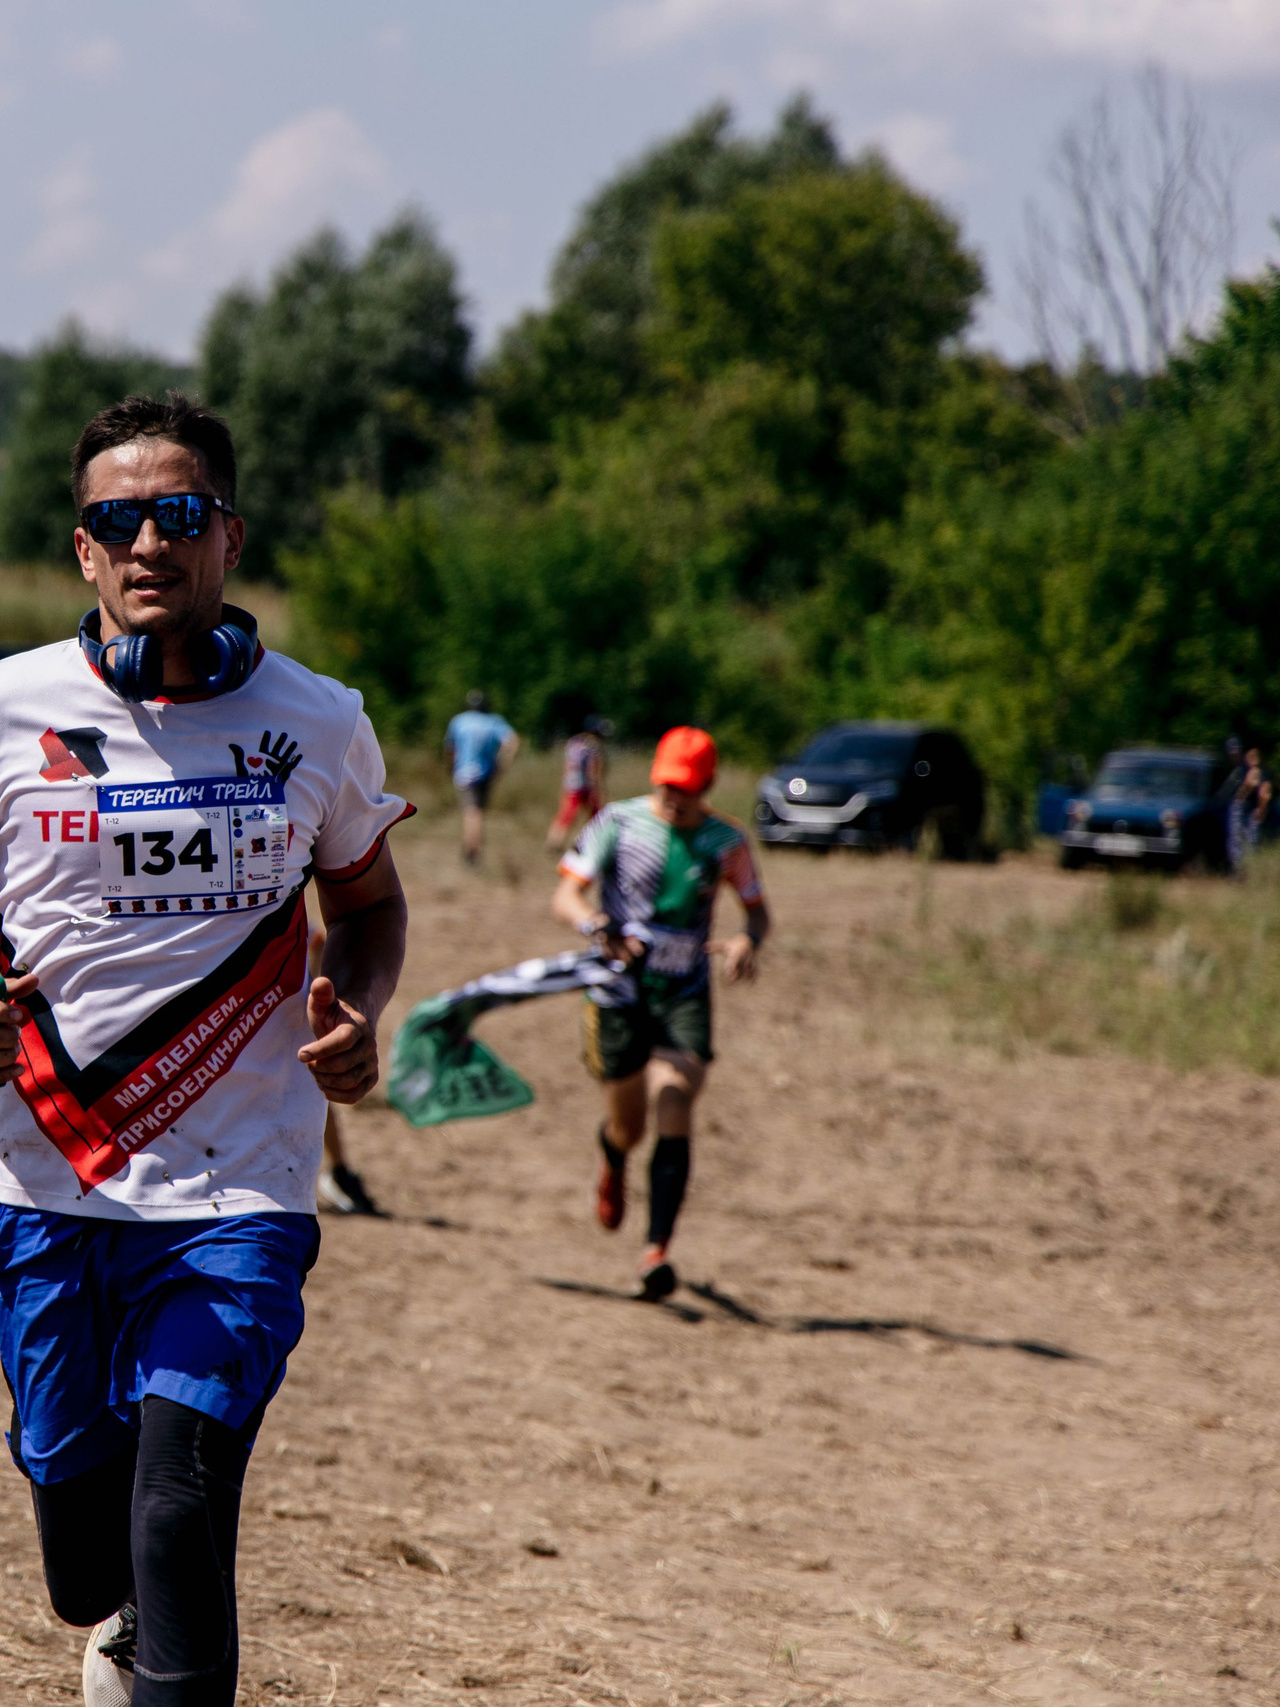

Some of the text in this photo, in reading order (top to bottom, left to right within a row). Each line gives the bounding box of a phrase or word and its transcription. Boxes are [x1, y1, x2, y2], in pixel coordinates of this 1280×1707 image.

[108, 779, 273, 808] ТЕРЕНТИЧ ТРЕЙЛ
[112, 828, 219, 877] 134
[113, 995, 244, 1109] МЫ ДЕЛАЕМ.
[116, 985, 284, 1152] ПРИСОЕДИНЯЙСЯ!
